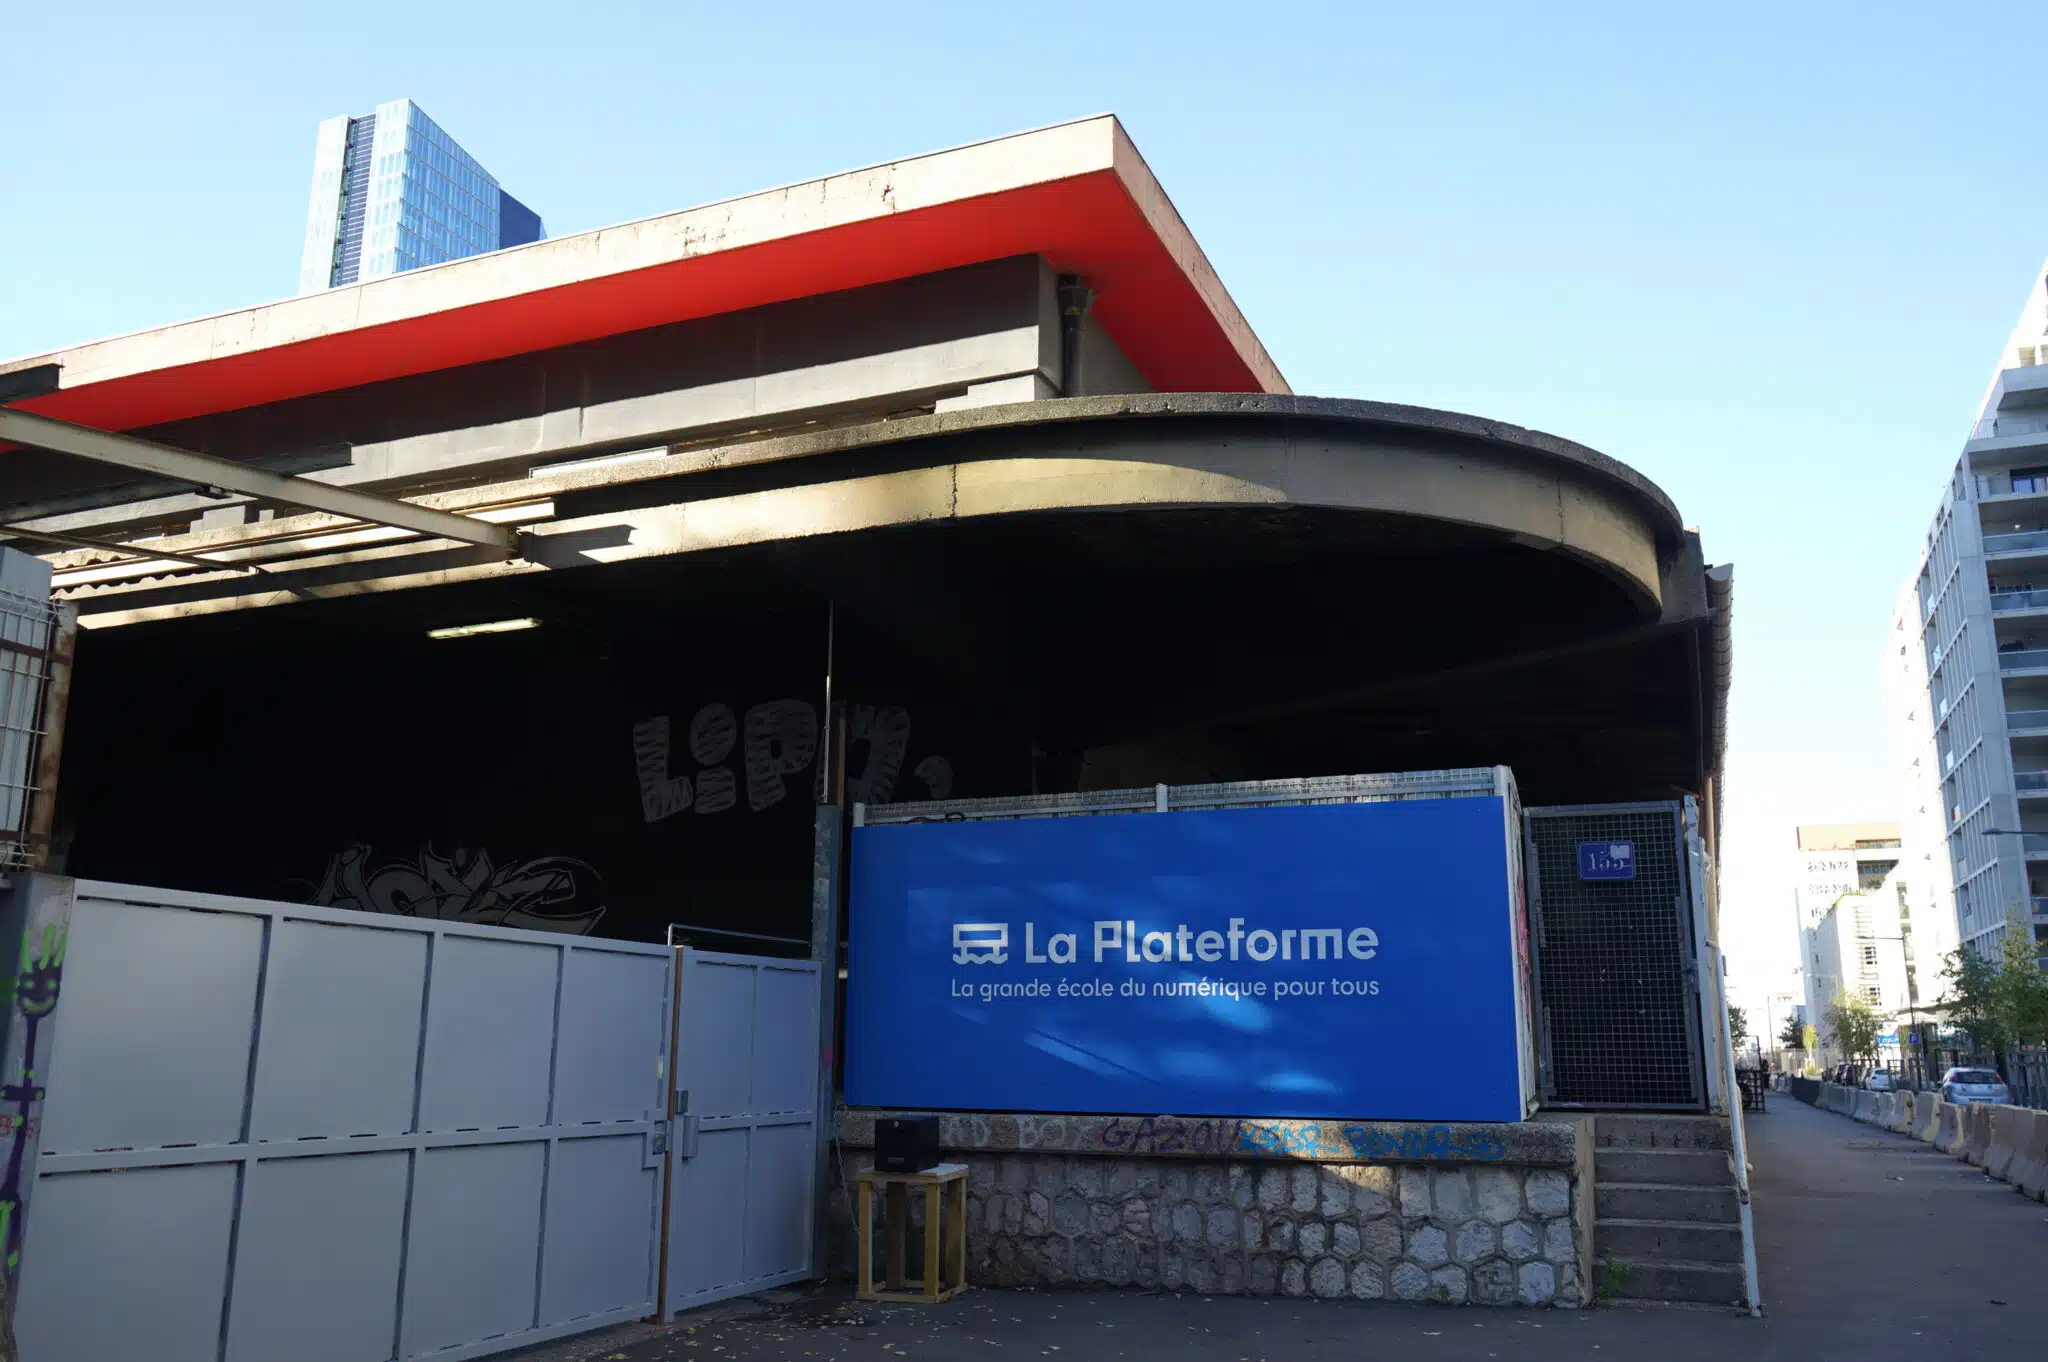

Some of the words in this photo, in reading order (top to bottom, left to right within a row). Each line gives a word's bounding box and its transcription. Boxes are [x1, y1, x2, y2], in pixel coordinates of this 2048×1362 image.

[1025, 922, 1077, 964] La
[1094, 917, 1379, 963] Plateforme
[951, 979, 974, 997] La
[979, 978, 1051, 1002] grande
[1057, 977, 1114, 997] école
[1120, 977, 1146, 997] du
[1153, 976, 1267, 1001] numérique
[1274, 981, 1325, 1001] pour
[1331, 977, 1380, 996] tous
